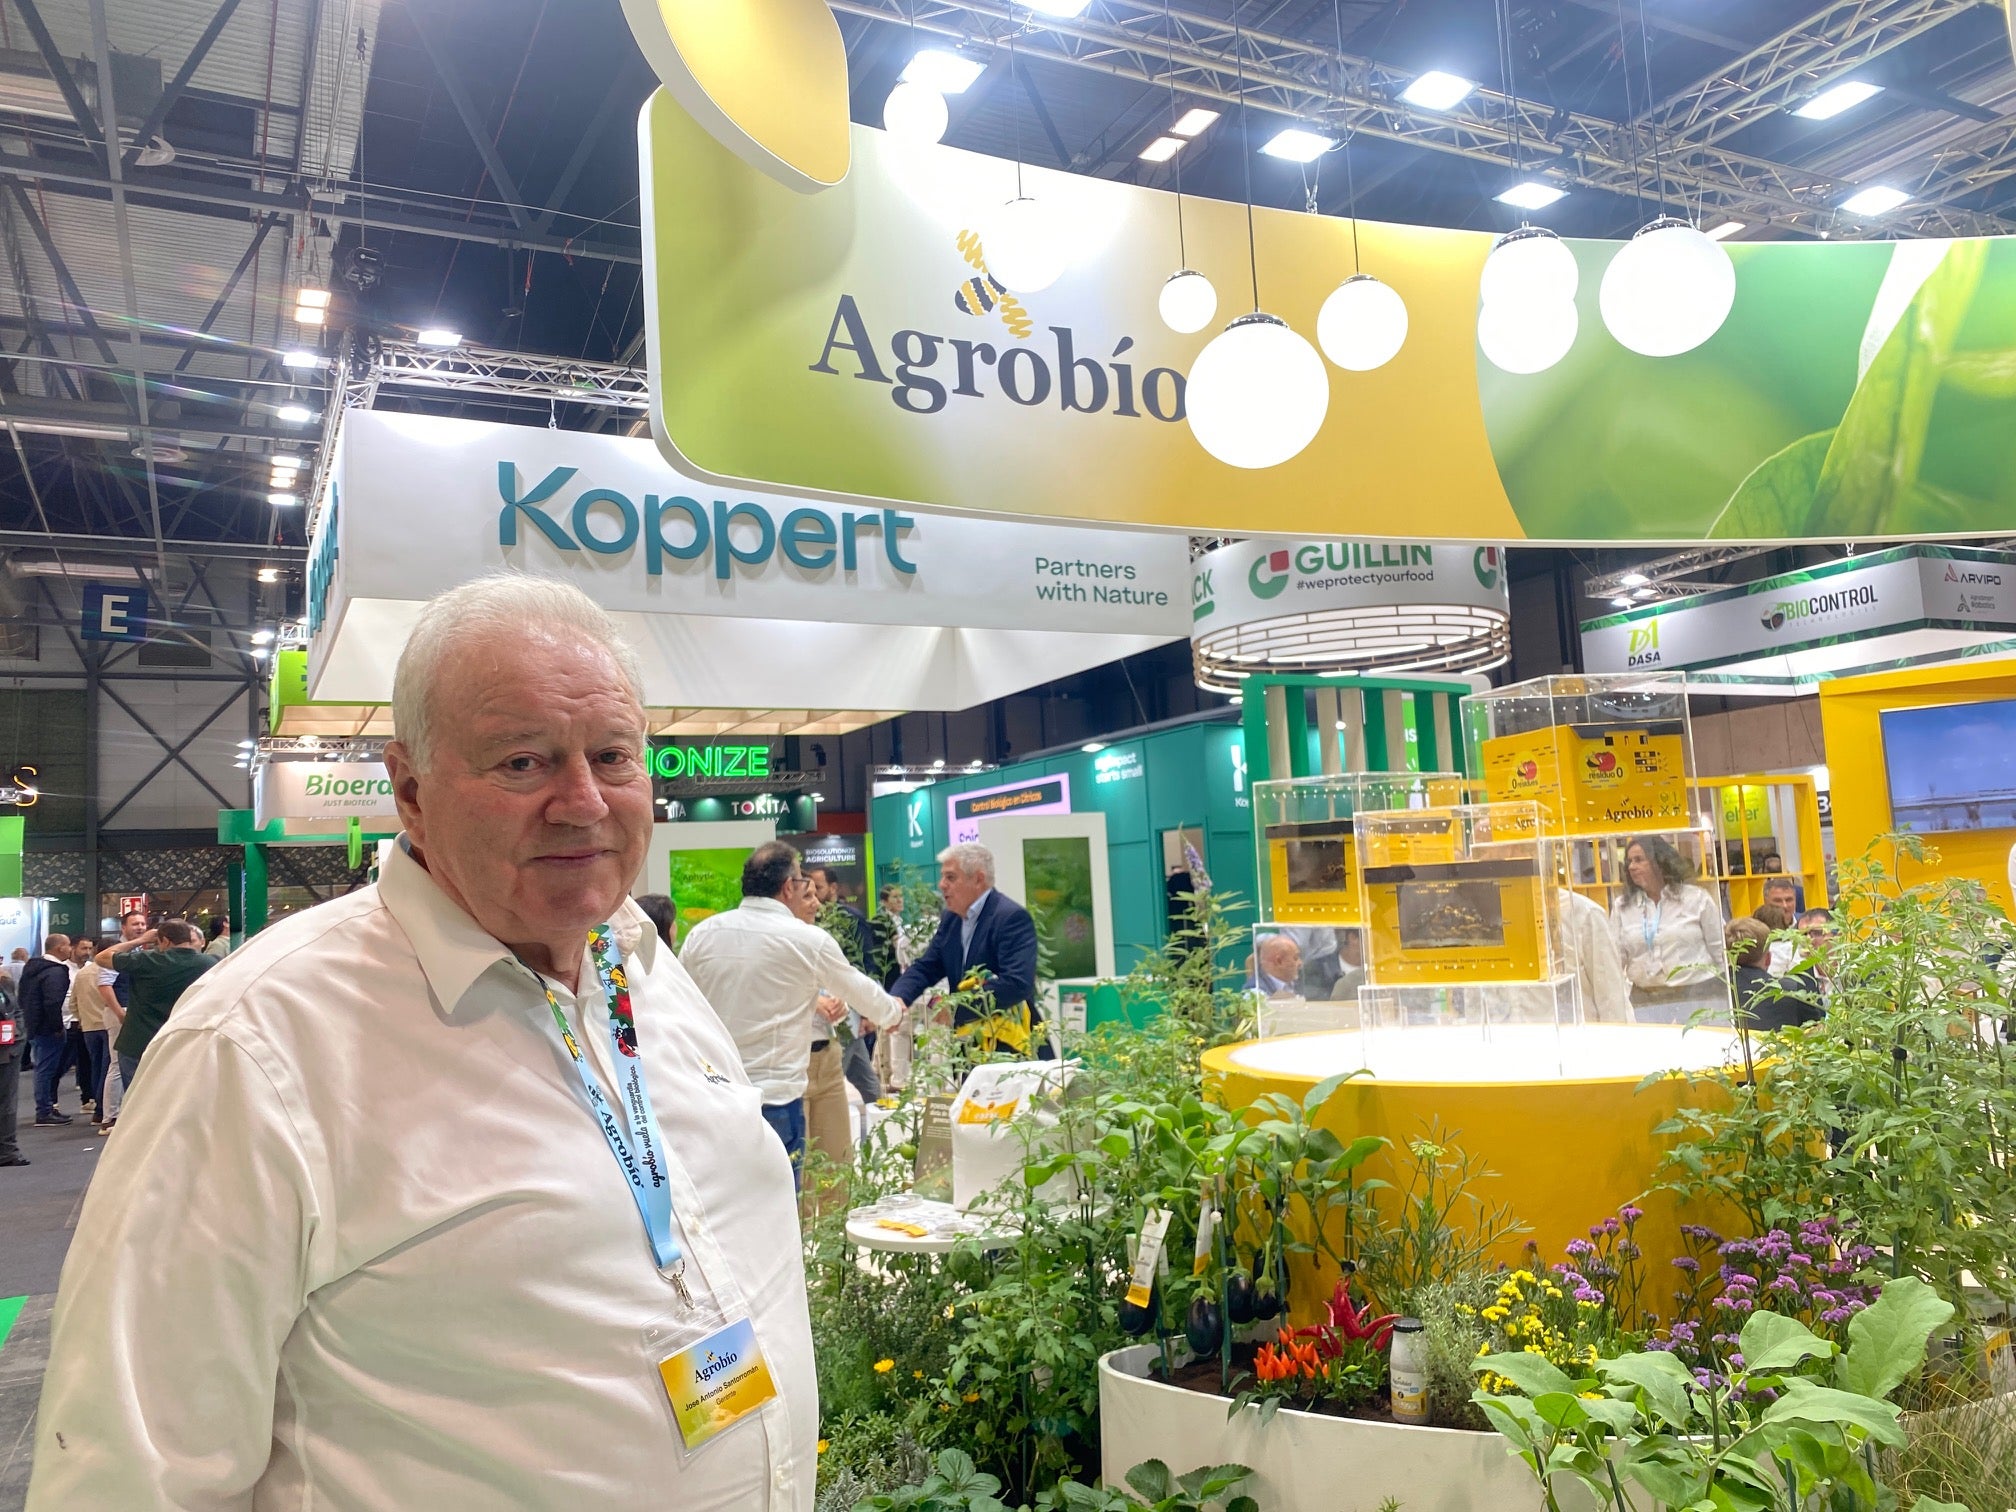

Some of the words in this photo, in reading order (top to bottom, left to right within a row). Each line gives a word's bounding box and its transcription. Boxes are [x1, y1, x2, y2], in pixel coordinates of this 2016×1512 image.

[808, 293, 1188, 423] Agrobío
[498, 461, 917, 580] Koppert
[1035, 557, 1136, 580] Partners
[1295, 543, 1432, 575] GUILLIN
[1036, 583, 1087, 603] with
[1093, 585, 1168, 607] Nature
[1192, 568, 1214, 605] CK
[1296, 570, 1434, 591] #weprotectyourfood
[1960, 573, 2002, 586] ARVIPO
[100, 594, 129, 634] E
[1786, 585, 1879, 621] BIOCONTROL
[1628, 651, 1661, 667] DASA
[731, 799, 790, 816] TOKITA
[805, 855, 856, 864] AGRICULTURE
[600, 1110, 641, 1187] Agrobío
[695, 1352, 738, 1383] Agrobío
[685, 1399, 700, 1412] Jose
[700, 1386, 723, 1403] Antonio
[723, 1364, 759, 1390] Santorromán
[715, 1390, 737, 1406] Gerente
